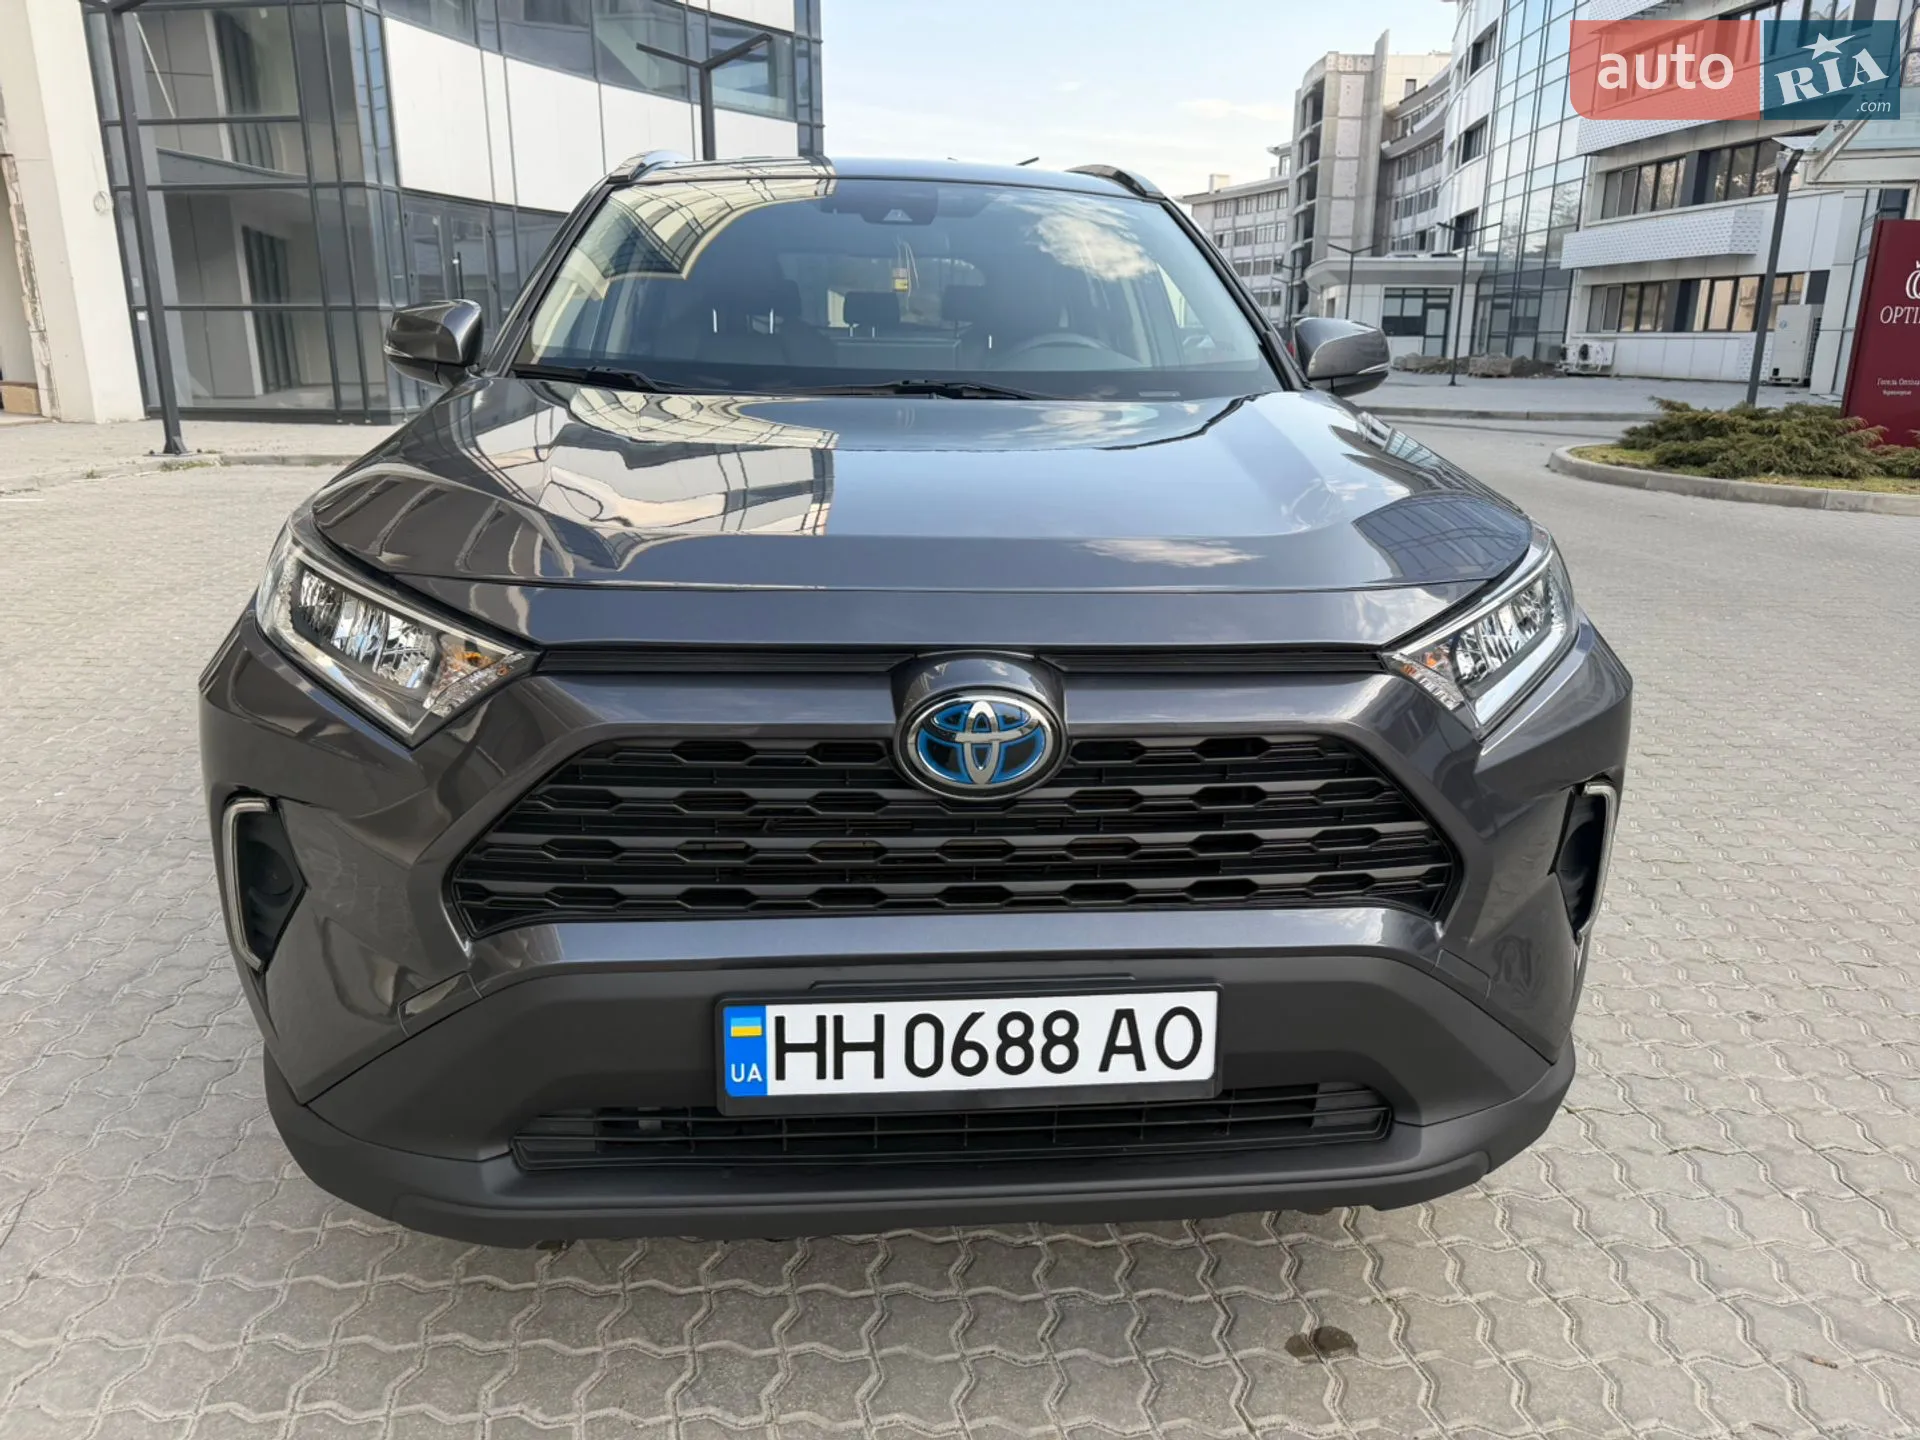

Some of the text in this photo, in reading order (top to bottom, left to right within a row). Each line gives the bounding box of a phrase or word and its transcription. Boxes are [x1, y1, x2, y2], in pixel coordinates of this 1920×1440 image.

[1880, 305, 1920, 324] OPTI
[774, 1005, 1203, 1081] HH 0688 AO
[731, 1063, 763, 1083] UA
